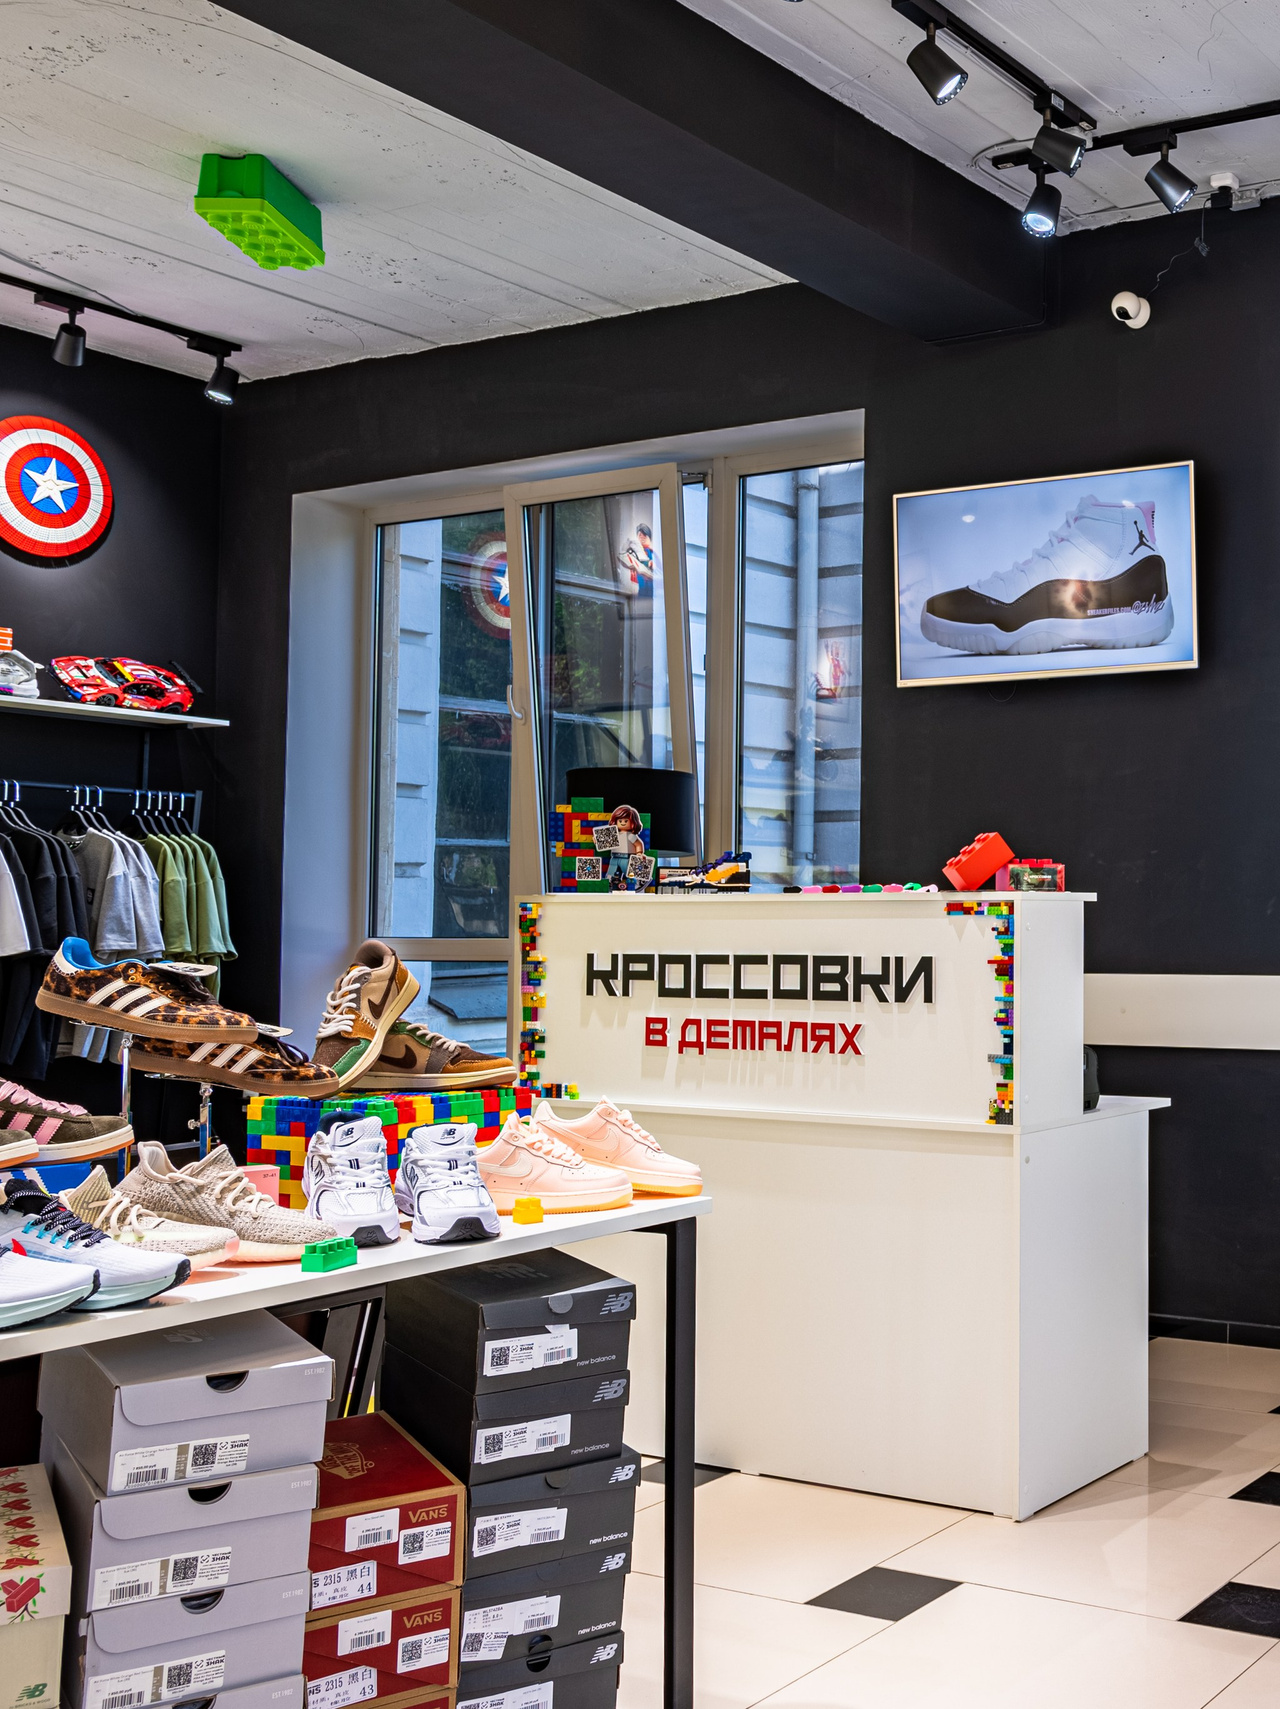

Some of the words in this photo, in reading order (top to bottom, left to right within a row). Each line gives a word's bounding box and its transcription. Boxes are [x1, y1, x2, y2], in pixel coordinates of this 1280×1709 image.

[586, 953, 935, 1004] КРОССОВКИ
[645, 1016, 670, 1047] В
[678, 1017, 865, 1056] ДЕТАЛЯХ
[600, 1292, 634, 1315] NB
[576, 1359, 590, 1367] new
[590, 1354, 616, 1364] balance
[592, 1379, 627, 1403] NB
[584, 1442, 610, 1453] balance
[608, 1464, 636, 1484] NB
[408, 1504, 449, 1523] VANS
[602, 1531, 628, 1542] balance
[599, 1553, 627, 1573] NB
[323, 1572, 342, 1586] 2315
[346, 1565, 370, 1582] 黑白
[357, 1582, 372, 1594] 44
[403, 1608, 443, 1629] VANS
[591, 1621, 617, 1632] balance
[205, 1659, 225, 1667] ЗНАК
[590, 1643, 618, 1664] NB
[325, 1677, 343, 1692] 2315
[348, 1668, 372, 1685] 黑白
[15, 1683, 48, 1702] NB
[360, 1684, 374, 1697] 43
